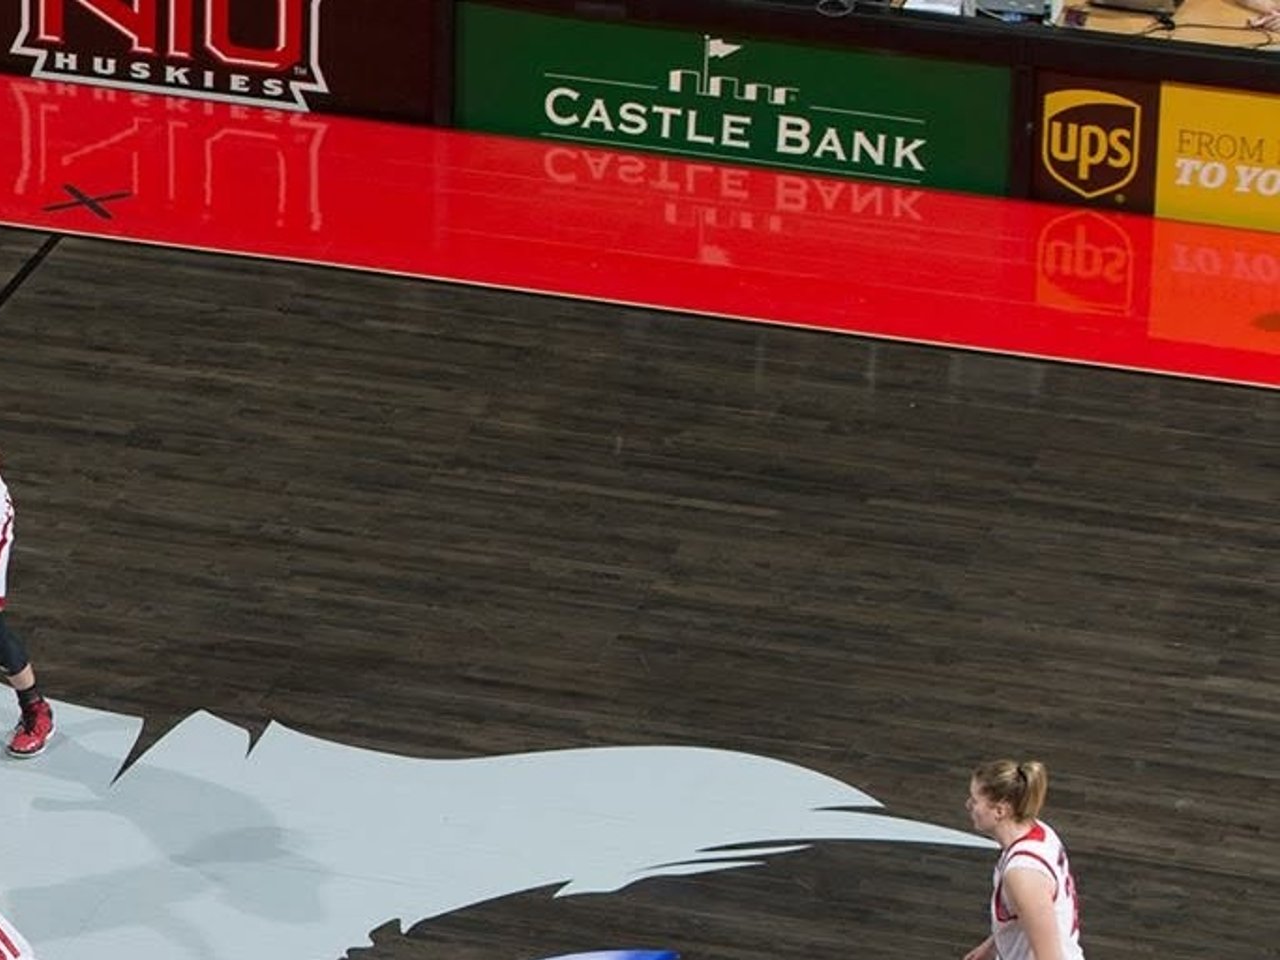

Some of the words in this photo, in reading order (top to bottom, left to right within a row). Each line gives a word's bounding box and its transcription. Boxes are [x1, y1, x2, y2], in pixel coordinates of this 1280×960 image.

[54, 51, 285, 96] HUSKIES
[544, 87, 752, 149] CASTLE
[777, 116, 927, 170] BANK
[1050, 120, 1131, 180] ups
[1176, 129, 1265, 163] FROM
[1175, 158, 1227, 188] TO
